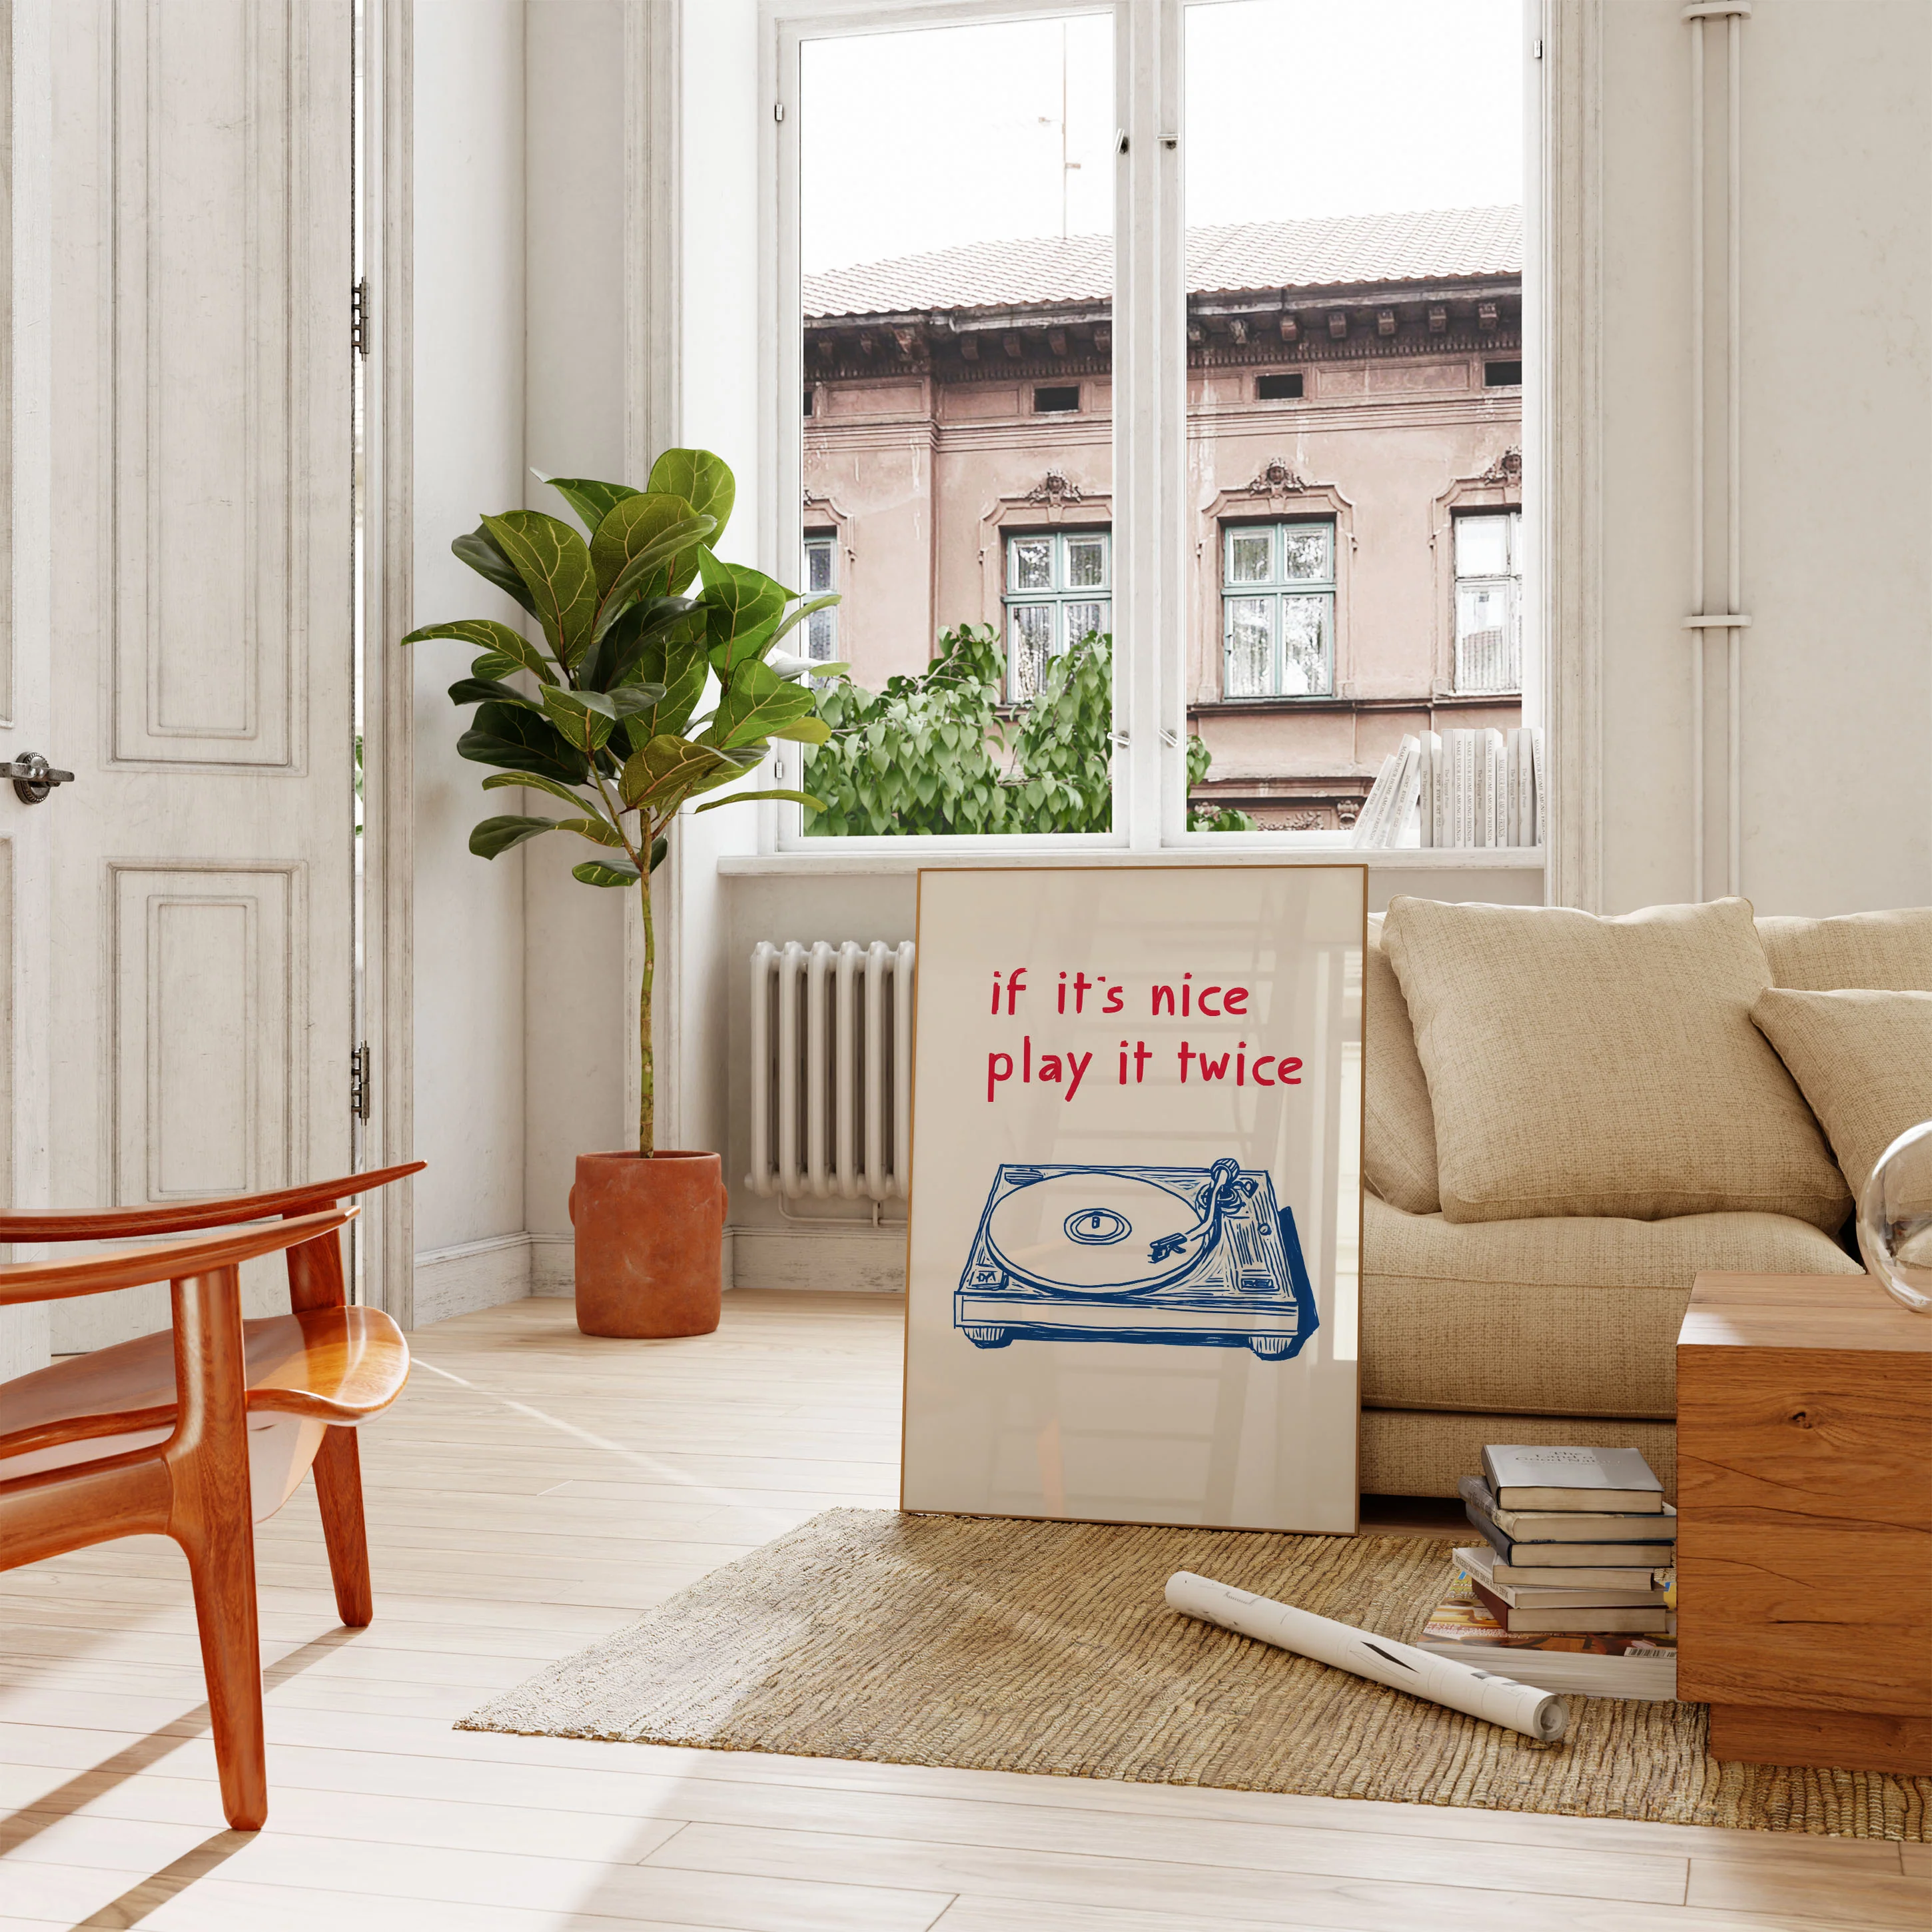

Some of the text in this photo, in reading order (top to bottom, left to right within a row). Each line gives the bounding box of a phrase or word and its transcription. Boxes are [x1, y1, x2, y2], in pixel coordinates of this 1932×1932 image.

[1393, 761, 1402, 777] YOUR
[1387, 777, 1396, 795] HOME
[1379, 795, 1388, 817] AMONG
[1369, 817, 1381, 841] FRIENDS
[991, 967, 1249, 1017] if it's nice
[987, 1035, 1303, 1103] play it twice
